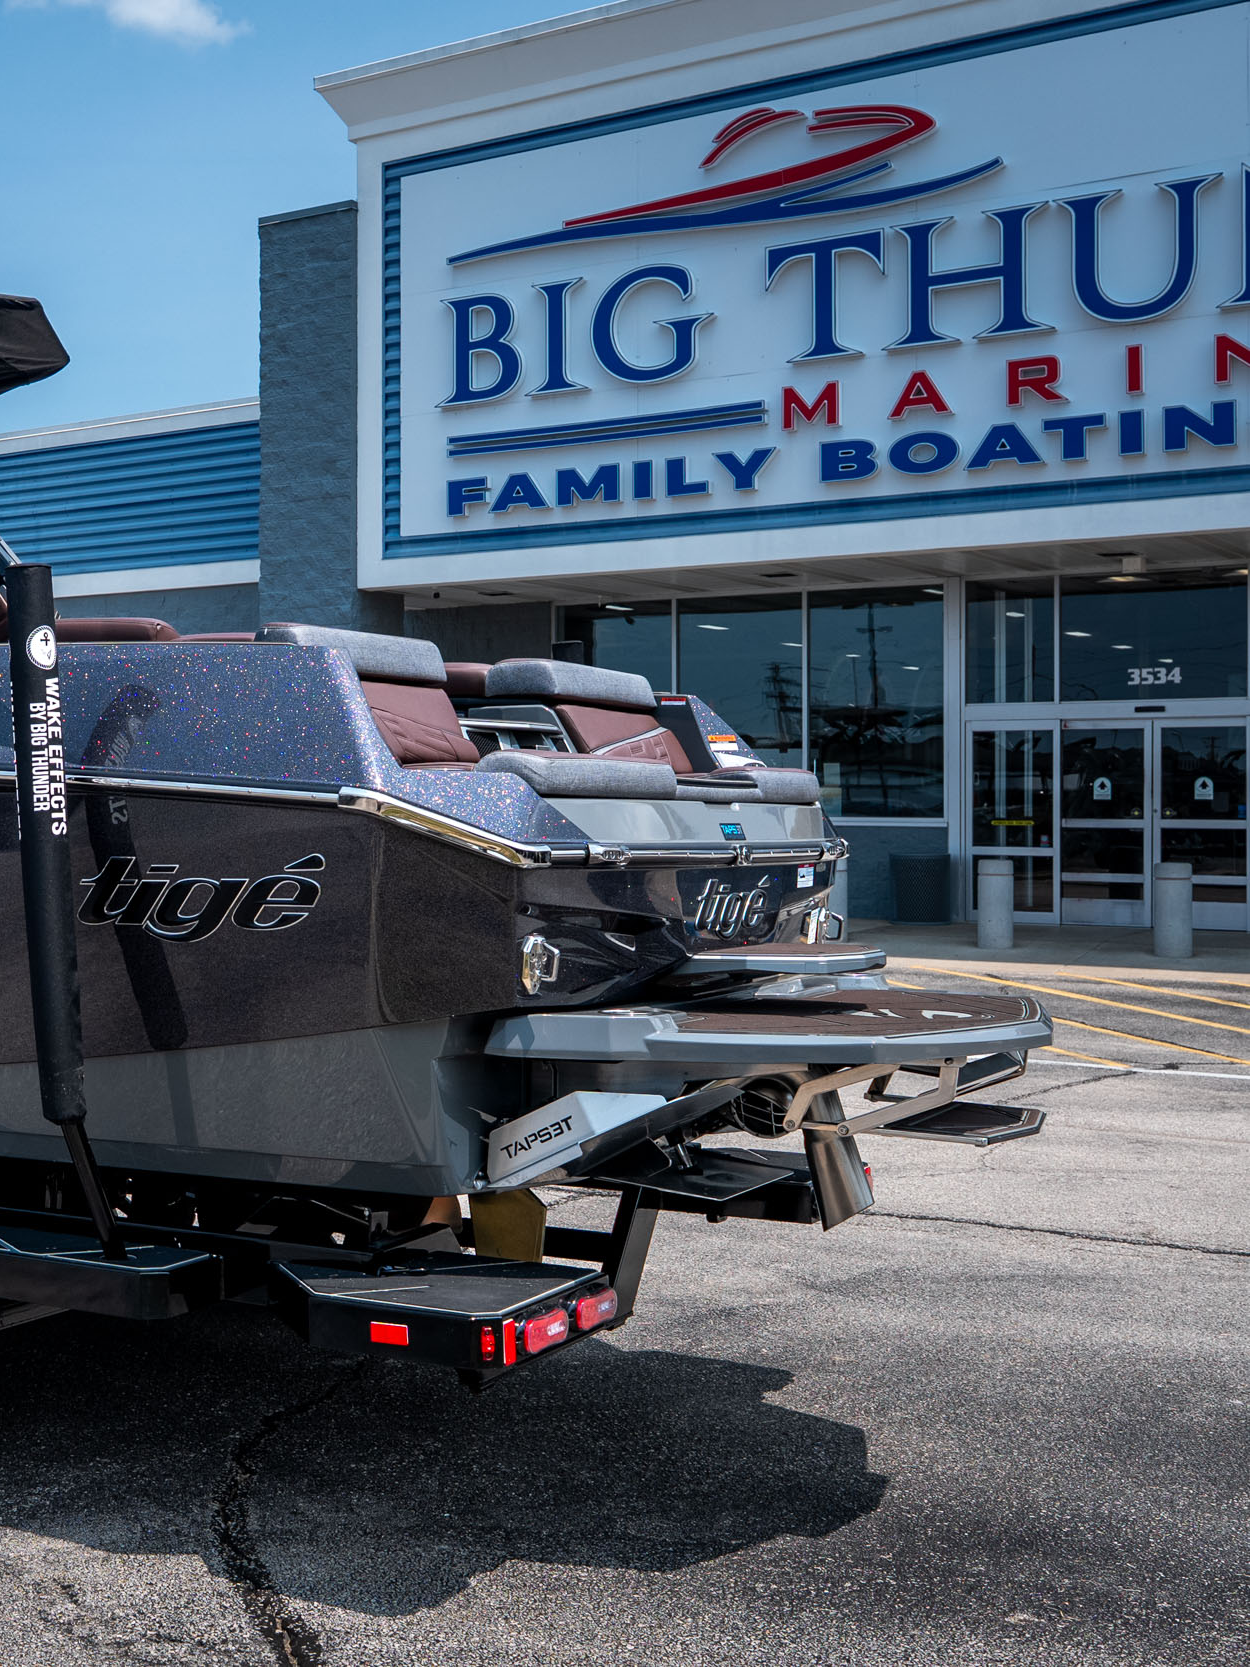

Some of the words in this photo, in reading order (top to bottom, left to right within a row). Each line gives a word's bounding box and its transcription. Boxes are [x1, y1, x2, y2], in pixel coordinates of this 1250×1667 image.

[435, 263, 716, 409] BIG
[446, 446, 777, 518] FAMILY
[819, 399, 1238, 483] BOATIN
[45, 677, 63, 739] WAKE
[1127, 666, 1183, 686] 3534
[29, 702, 47, 721] BY
[30, 723, 48, 746] BIG
[31, 747, 51, 812] THUNDER
[48, 744, 68, 836] EFFECTS
[77, 853, 326, 944] tigé
[694, 874, 771, 941] tigé
